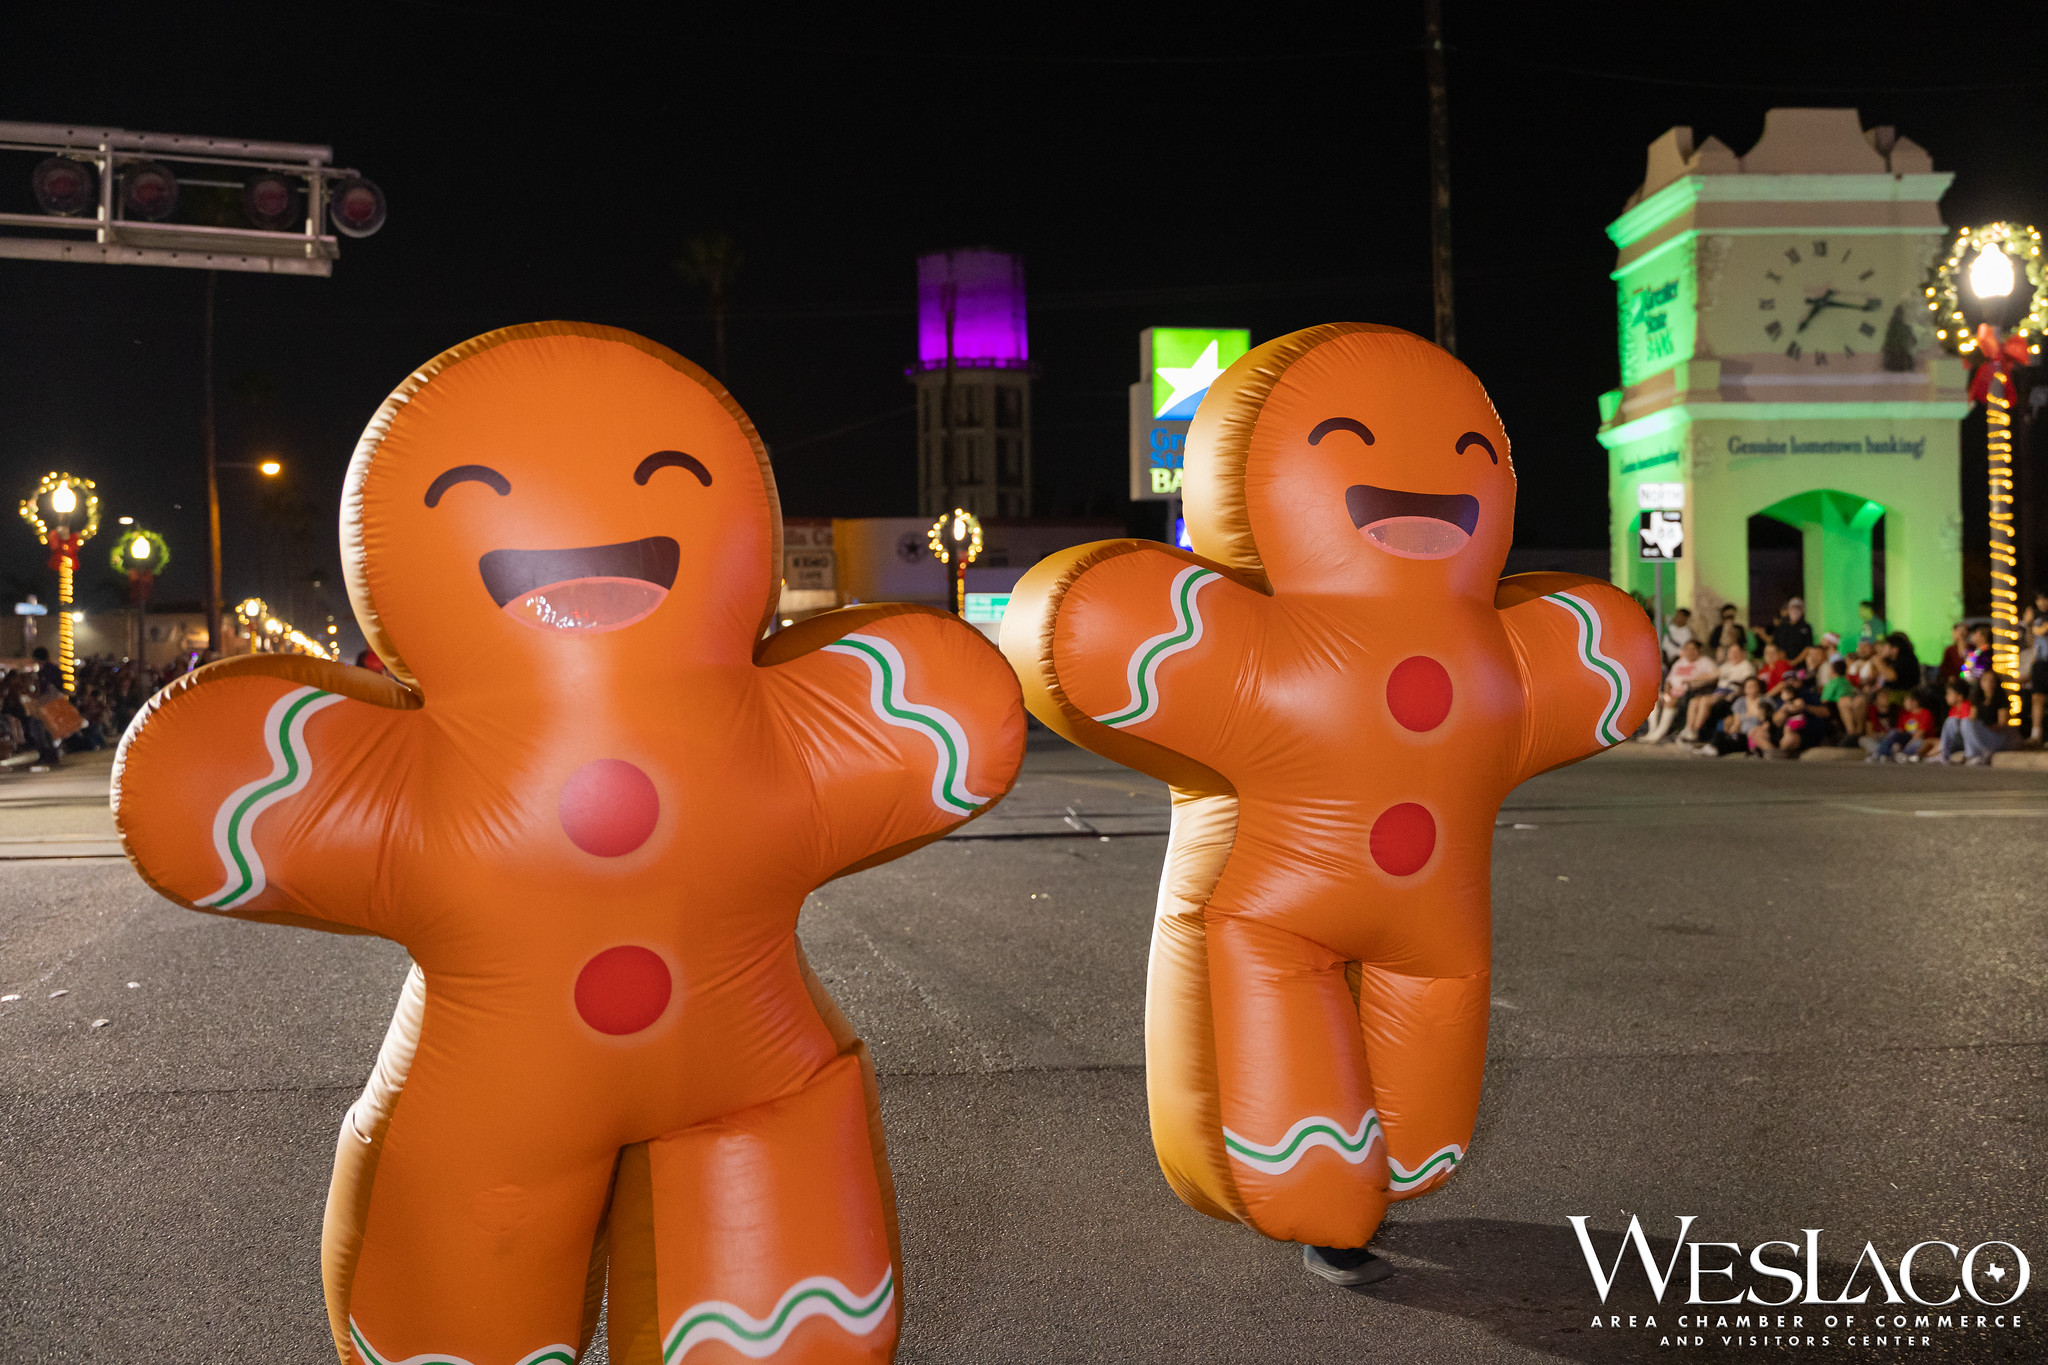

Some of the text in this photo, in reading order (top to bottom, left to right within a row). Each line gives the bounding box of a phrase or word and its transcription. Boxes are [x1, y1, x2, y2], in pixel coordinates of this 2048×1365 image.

[1150, 427, 1186, 451] Gr
[1727, 434, 1787, 454] Genuine
[1790, 434, 1863, 454] hometown
[1150, 450, 1184, 469] Sta
[1149, 467, 1183, 493] BA
